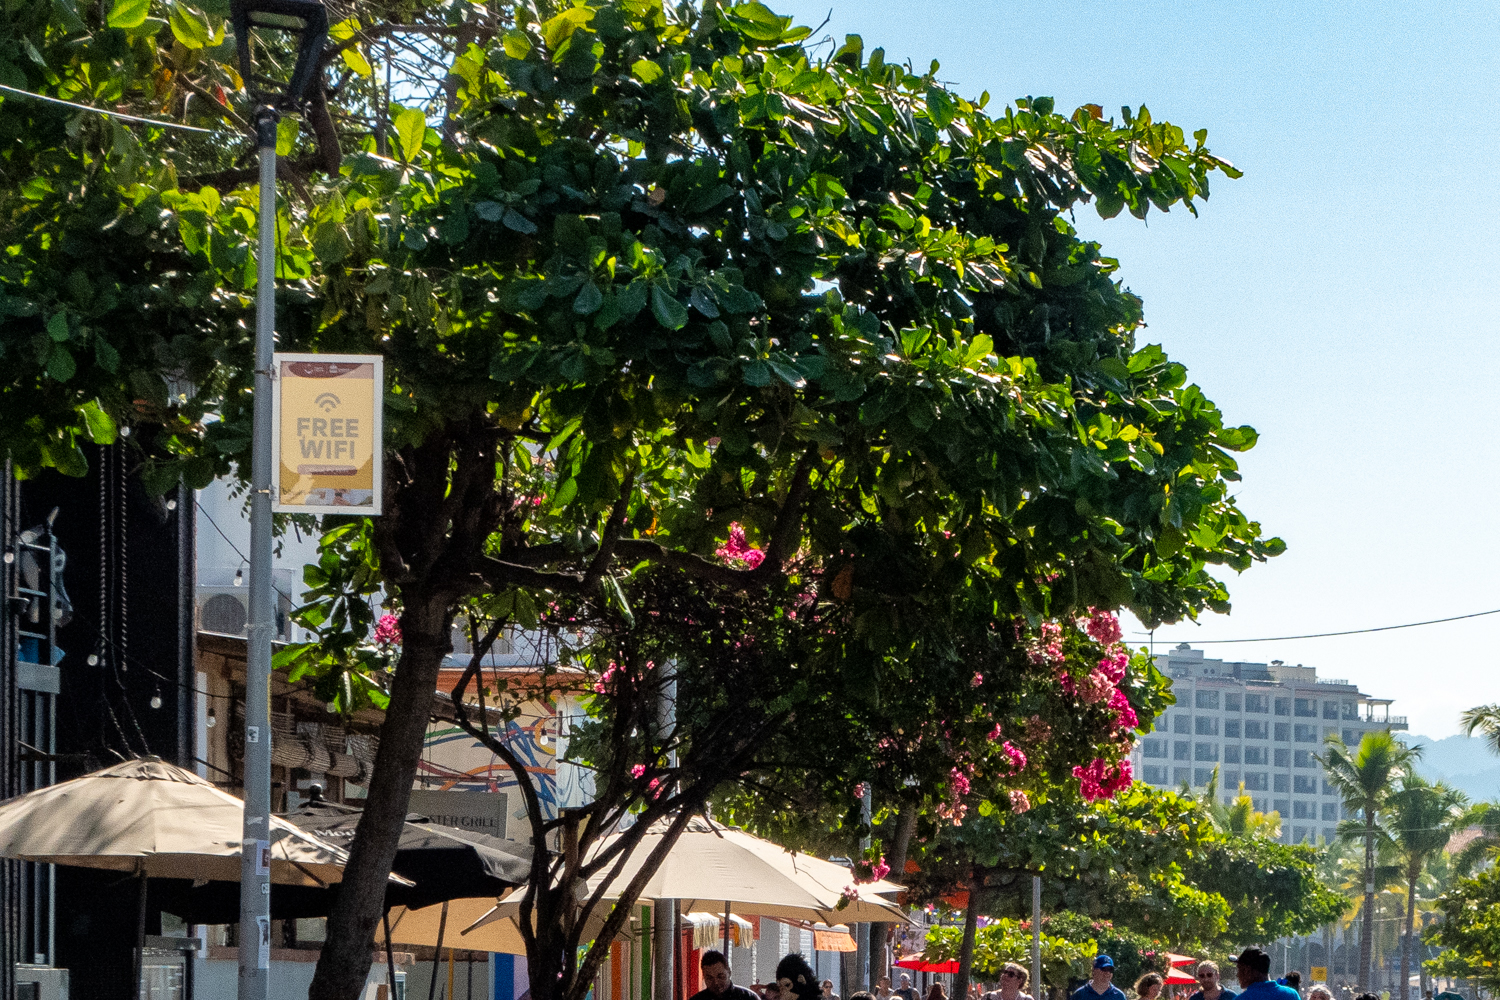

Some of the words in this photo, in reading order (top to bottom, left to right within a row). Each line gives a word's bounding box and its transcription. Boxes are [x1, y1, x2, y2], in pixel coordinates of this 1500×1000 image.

[296, 417, 359, 438] FREE
[299, 439, 355, 459] WIFI
[428, 814, 458, 827] STER
[460, 815, 497, 828] GRILL
[313, 828, 356, 838] Mod
